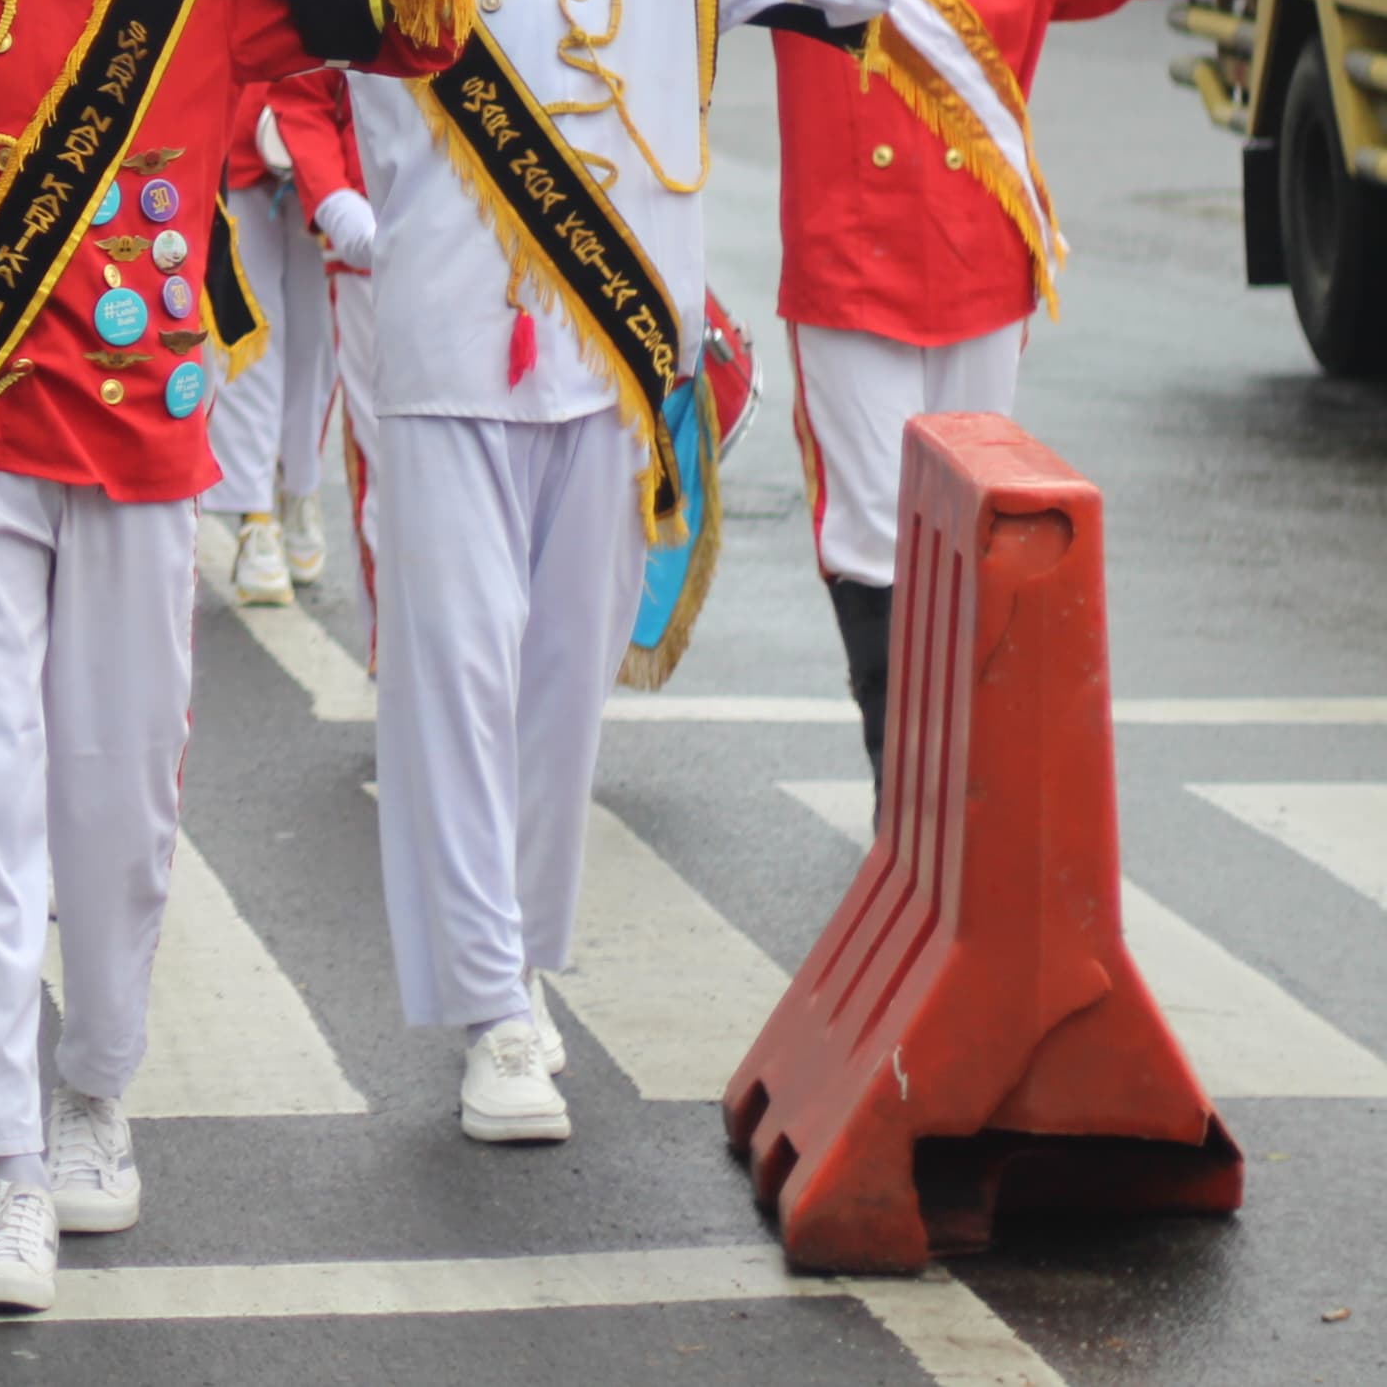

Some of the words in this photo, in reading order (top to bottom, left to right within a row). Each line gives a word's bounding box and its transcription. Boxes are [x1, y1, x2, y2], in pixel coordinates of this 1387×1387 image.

[96, 20, 148, 105] SWARA
[56, 105, 113, 174] NADA
[149, 186, 171, 209] 30
[461, 76, 521, 152] SWARA
[509, 149, 568, 214] NADA
[554, 210, 638, 311] KARTIKA
